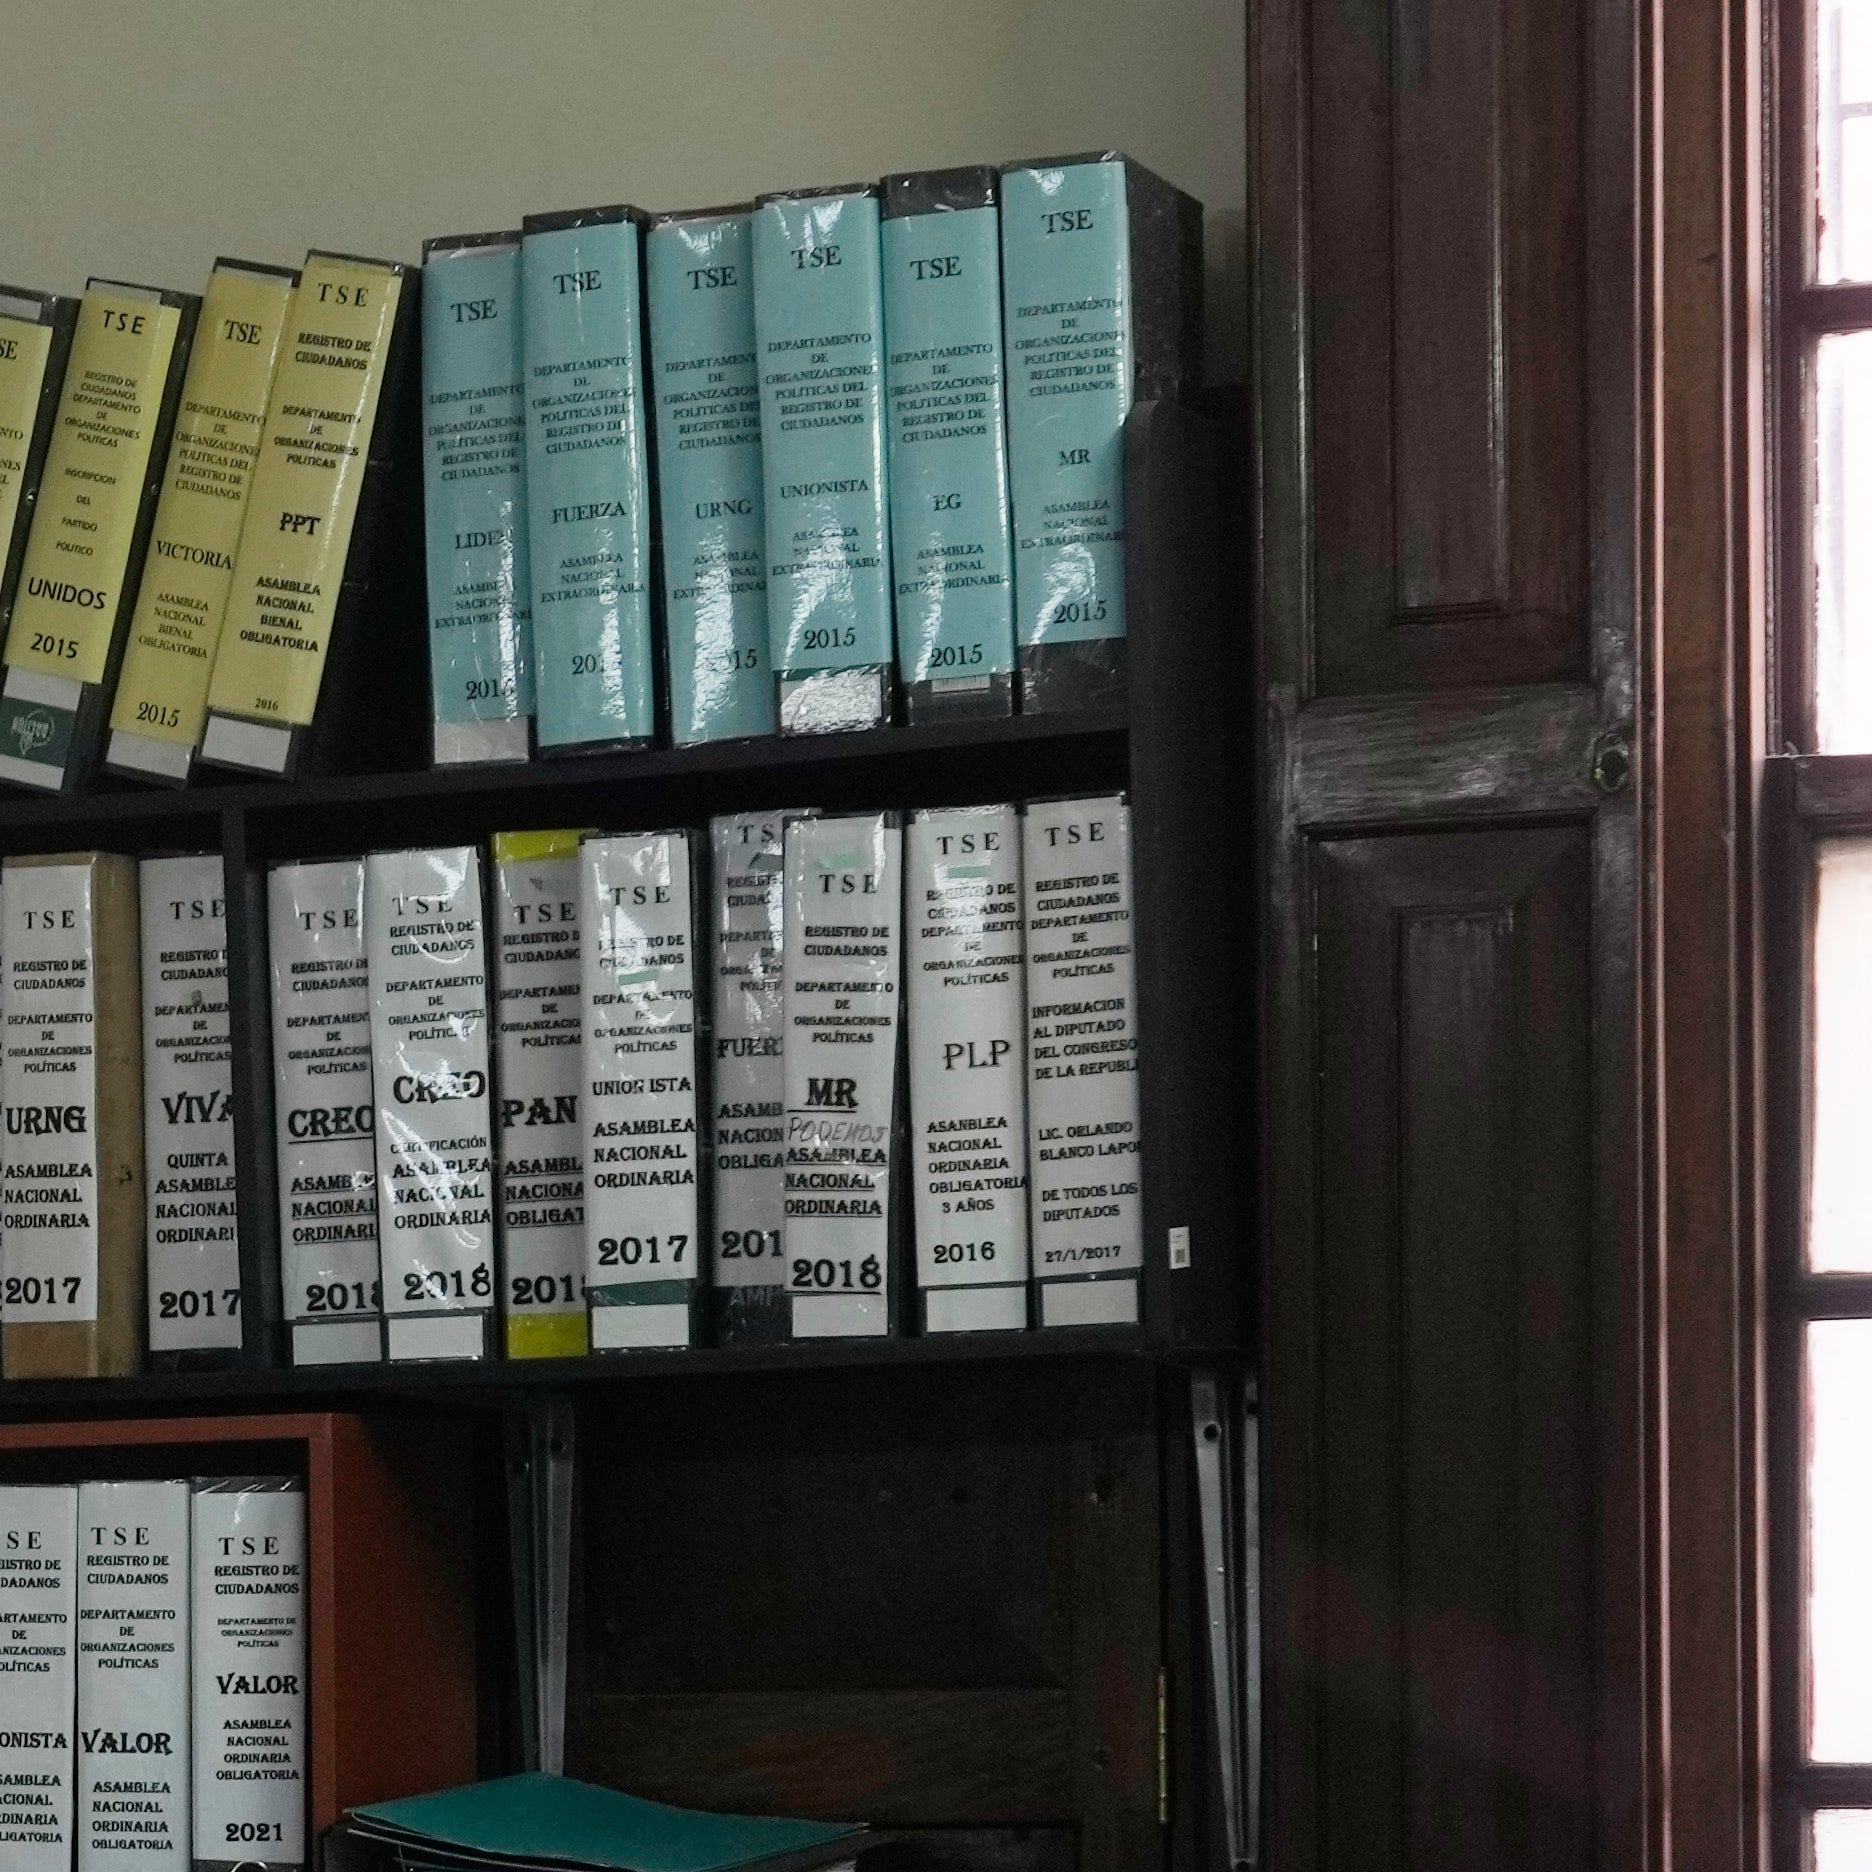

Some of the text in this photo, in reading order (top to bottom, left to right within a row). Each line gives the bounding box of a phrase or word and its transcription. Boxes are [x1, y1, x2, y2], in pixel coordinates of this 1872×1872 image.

[1041, 209, 1094, 234] TSE
[790, 246, 842, 270] TSE
[553, 269, 602, 295] TSE
[224, 320, 262, 346] TSE
[1058, 448, 1091, 467] MR
[780, 478, 869, 499] UNIONISTA
[551, 500, 628, 524] FUERZA
[695, 498, 752, 520] URNG
[933, 494, 962, 512] EG
[278, 512, 321, 537] PPT
[155, 539, 233, 571] VICTORIA
[28, 577, 107, 610] UNIDOS
[30, 633, 79, 661] 2015
[929, 644, 983, 668] 2015
[1032, 998, 1126, 1018] INFORMACION
[1056, 1019, 1126, 1036] DIPUTADO
[943, 1040, 1011, 1071] PLP
[393, 1070, 486, 1104] CREO
[807, 1079, 859, 1108] MR
[5, 1105, 87, 1136] URNG
[501, 1096, 578, 1126] PAN
[166, 1152, 229, 1170] QUINTA
[1039, 1144, 1094, 1161] BLANCO
[4, 1162, 93, 1180] ASAMBLEA
[942, 1197, 995, 1214] 3 AÑOS
[1043, 1204, 1120, 1222] DIPUTADOS
[4, 1212, 90, 1229] ORDINARIA
[933, 1242, 996, 1264] 2016
[1044, 1245, 1121, 1263] 27/1/2017
[160, 1289, 240, 1319] 2017
[216, 1673, 299, 1695] VALOR
[223, 1719, 292, 1731] ASAMBLEA
[81, 1730, 173, 1754] VALOR
[225, 1823, 284, 1842] 2021
